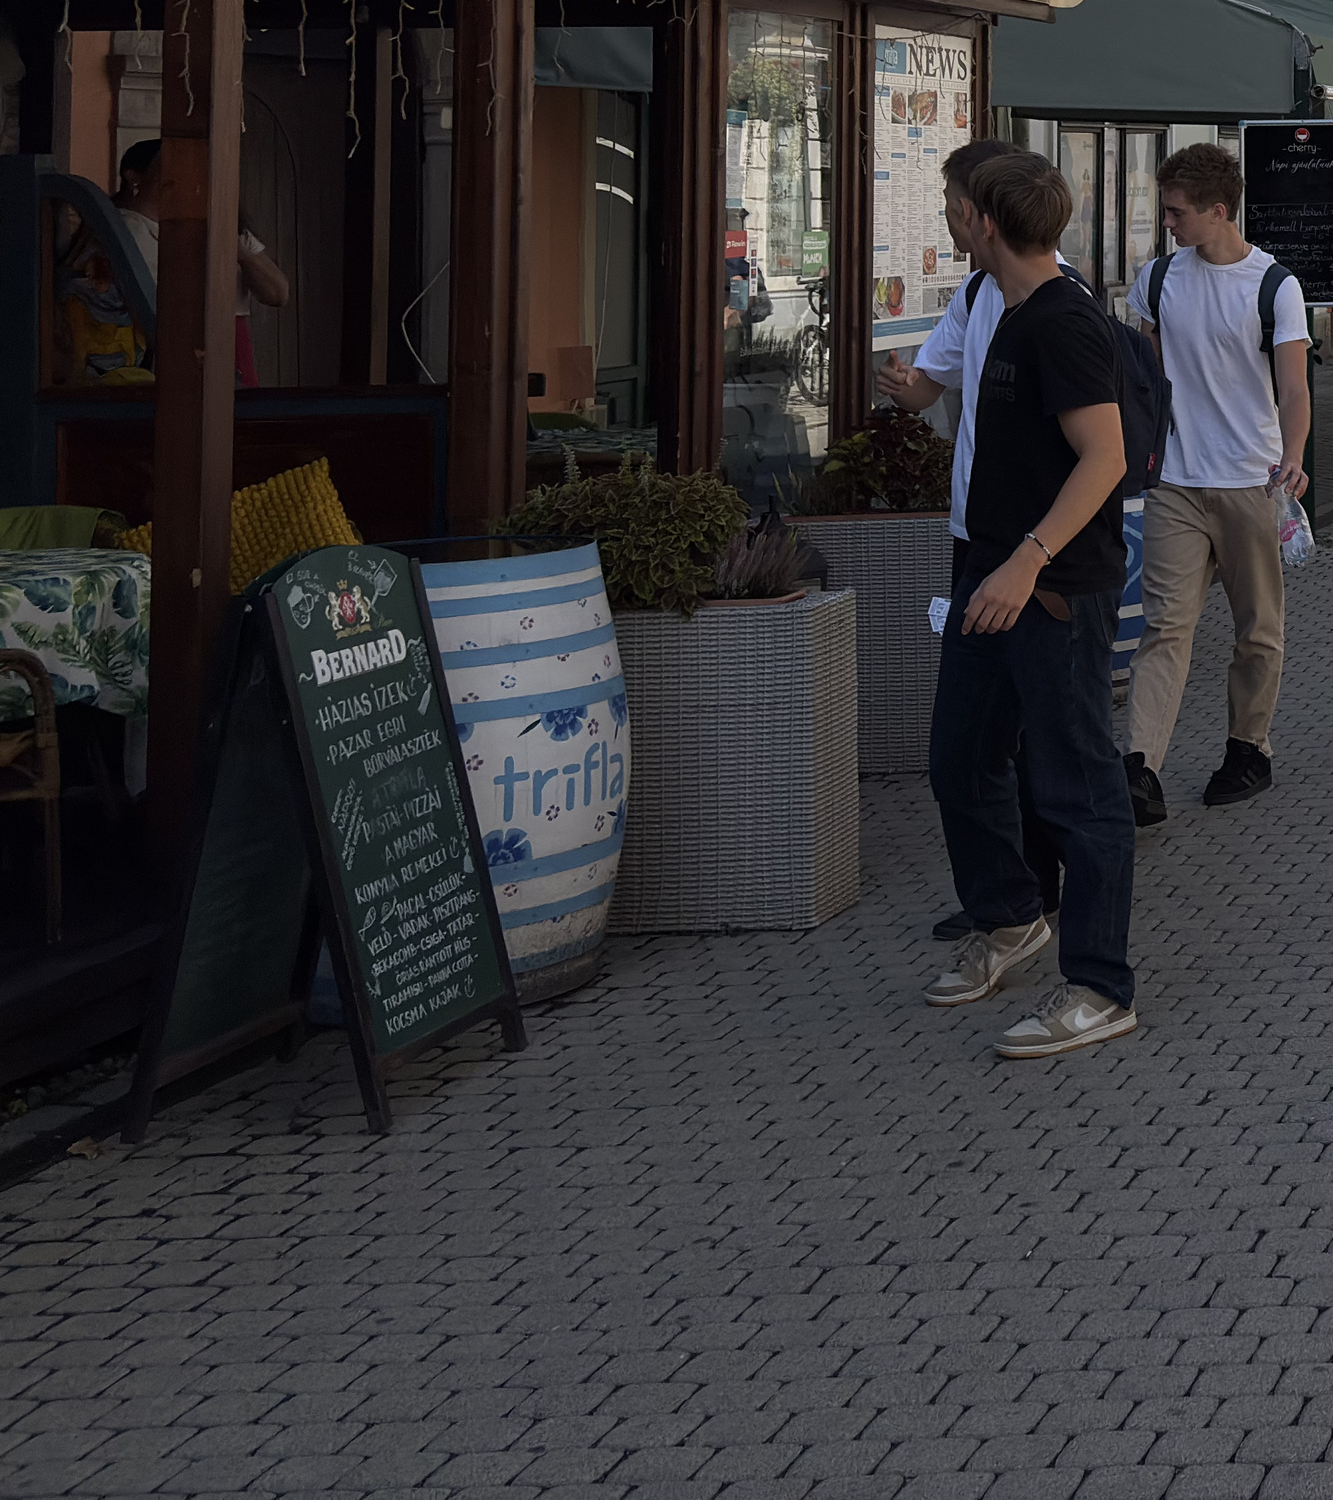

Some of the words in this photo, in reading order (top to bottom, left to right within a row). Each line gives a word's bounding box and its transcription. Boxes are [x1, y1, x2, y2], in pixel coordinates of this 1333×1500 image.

[908, 44, 967, 81] NEWS
[310, 628, 407, 687] BERNARD
[327, 729, 375, 766] PAZAR
[376, 714, 407, 743] EGRI
[362, 728, 443, 778] BORVÁLASZTÉK
[393, 820, 440, 857] MAGYAR
[385, 1002, 428, 1036] KOCSMA
